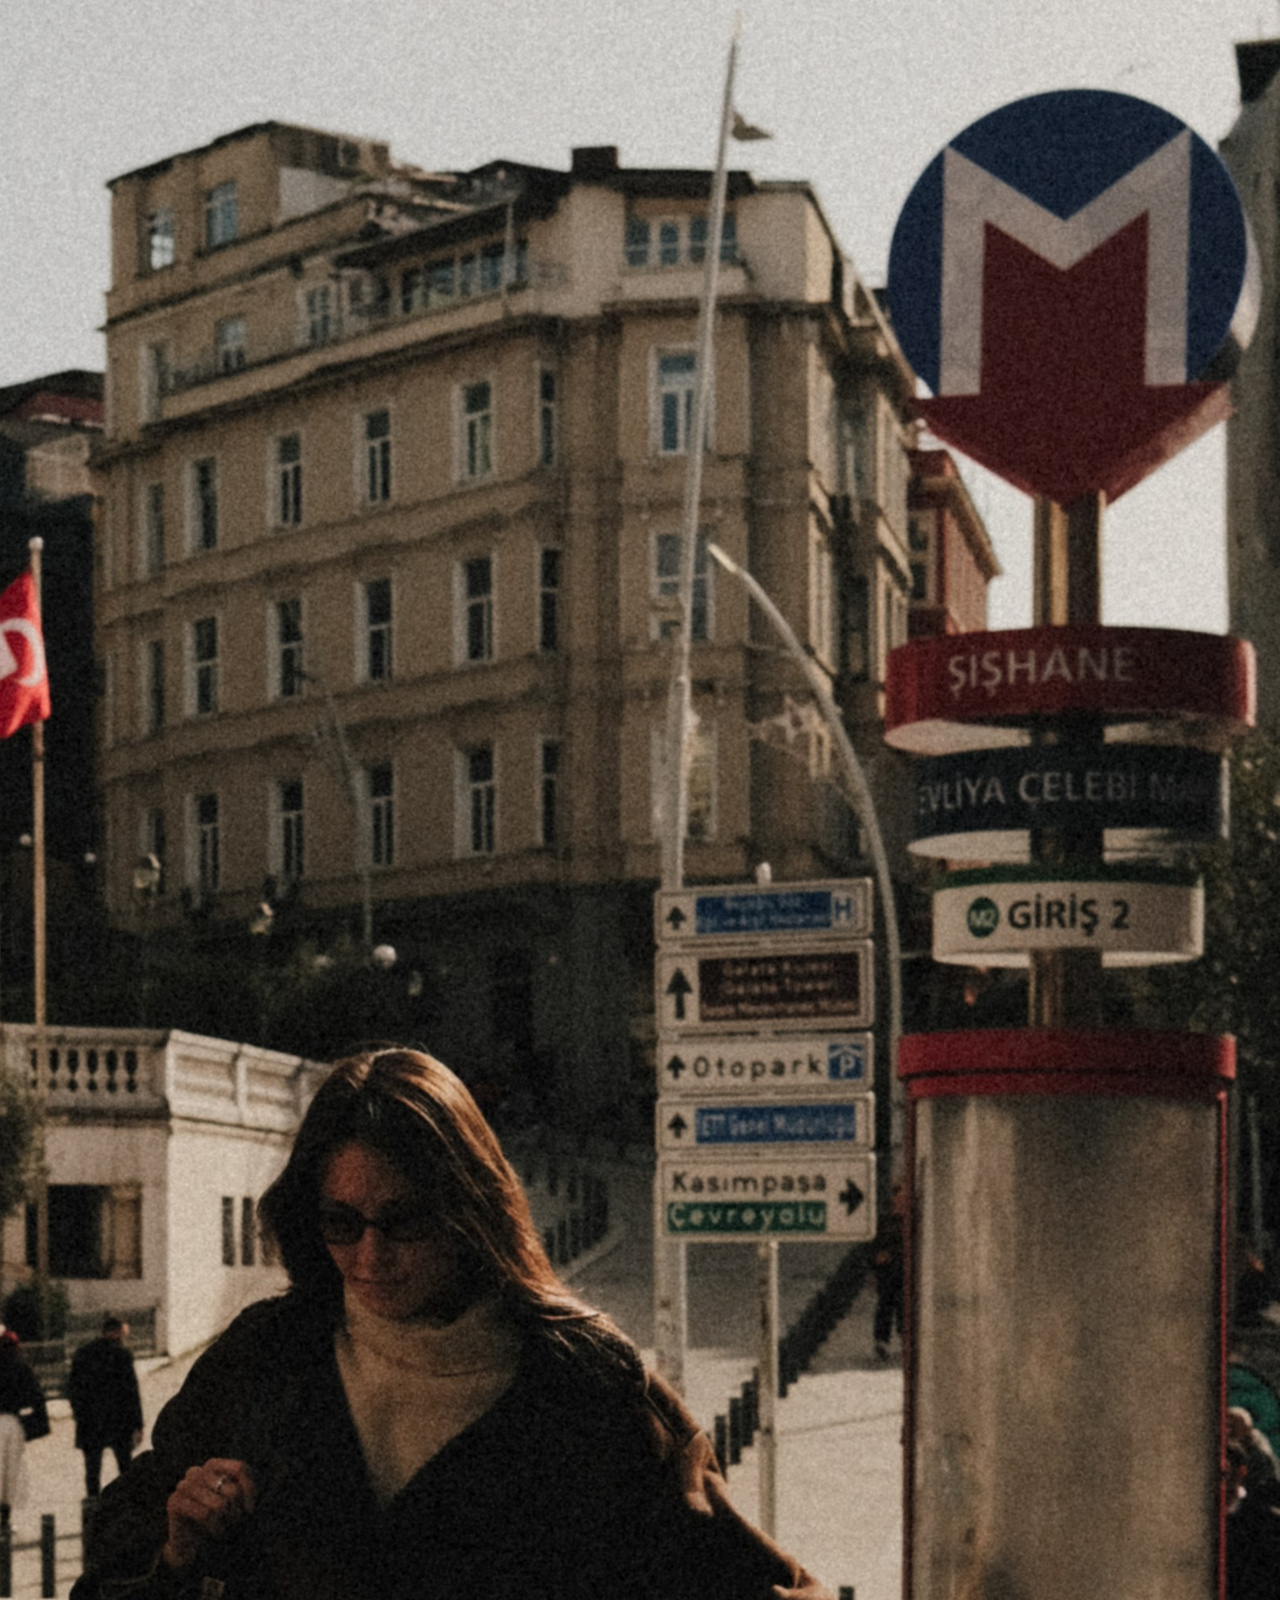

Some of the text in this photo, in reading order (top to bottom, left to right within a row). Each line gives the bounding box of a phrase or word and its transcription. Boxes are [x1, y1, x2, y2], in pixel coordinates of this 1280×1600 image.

[1008, 893, 1099, 936] GİRİŞ
[1112, 899, 1129, 929] 2
[693, 1054, 823, 1081] Otopark
[672, 1171, 826, 1197] Kasımpaşa
